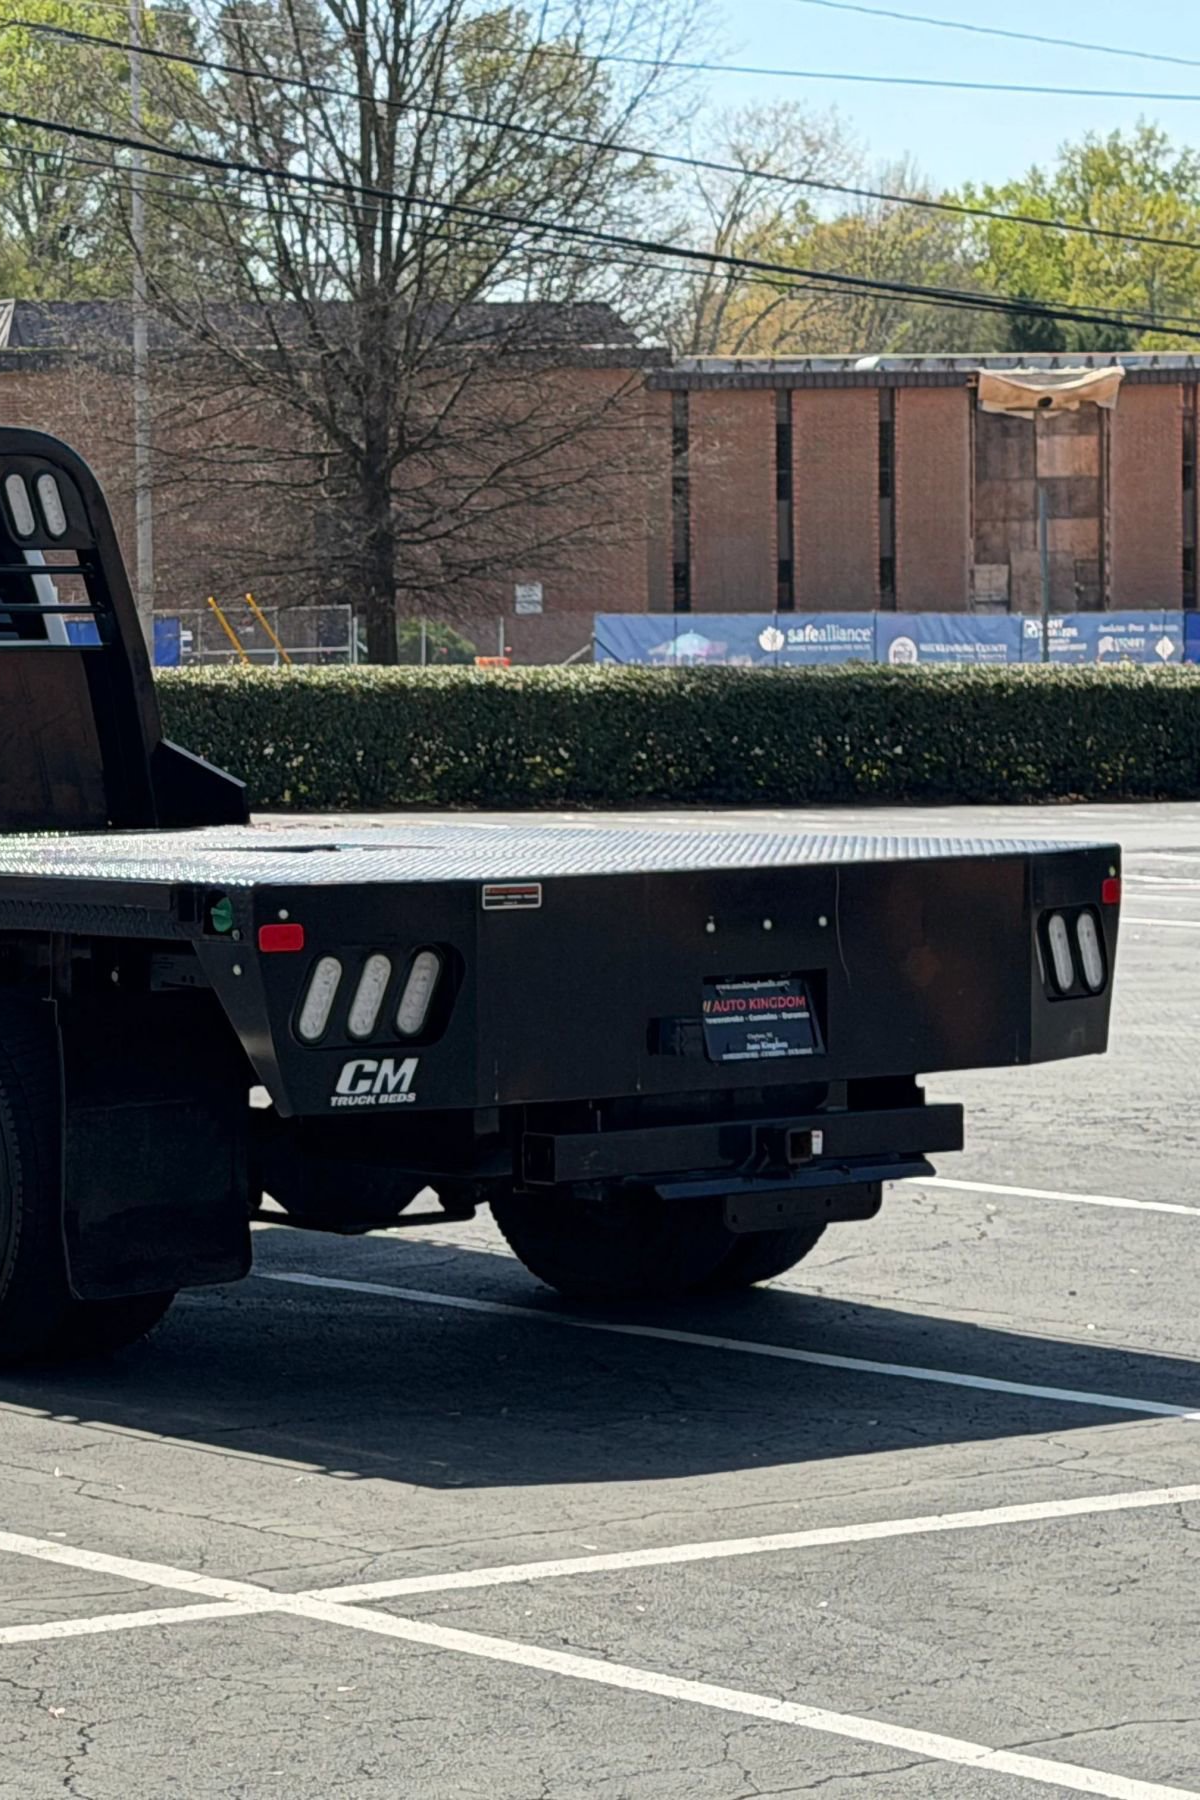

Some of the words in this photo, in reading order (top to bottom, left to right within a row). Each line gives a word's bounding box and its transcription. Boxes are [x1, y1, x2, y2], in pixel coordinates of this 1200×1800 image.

[787, 624, 872, 643] safealliance
[712, 1000, 747, 1013] AUTO
[749, 995, 806, 1010] KINGDOM
[335, 1058, 419, 1094] CM
[330, 1095, 377, 1107] TRUCK
[378, 1092, 417, 1104] BEDS
